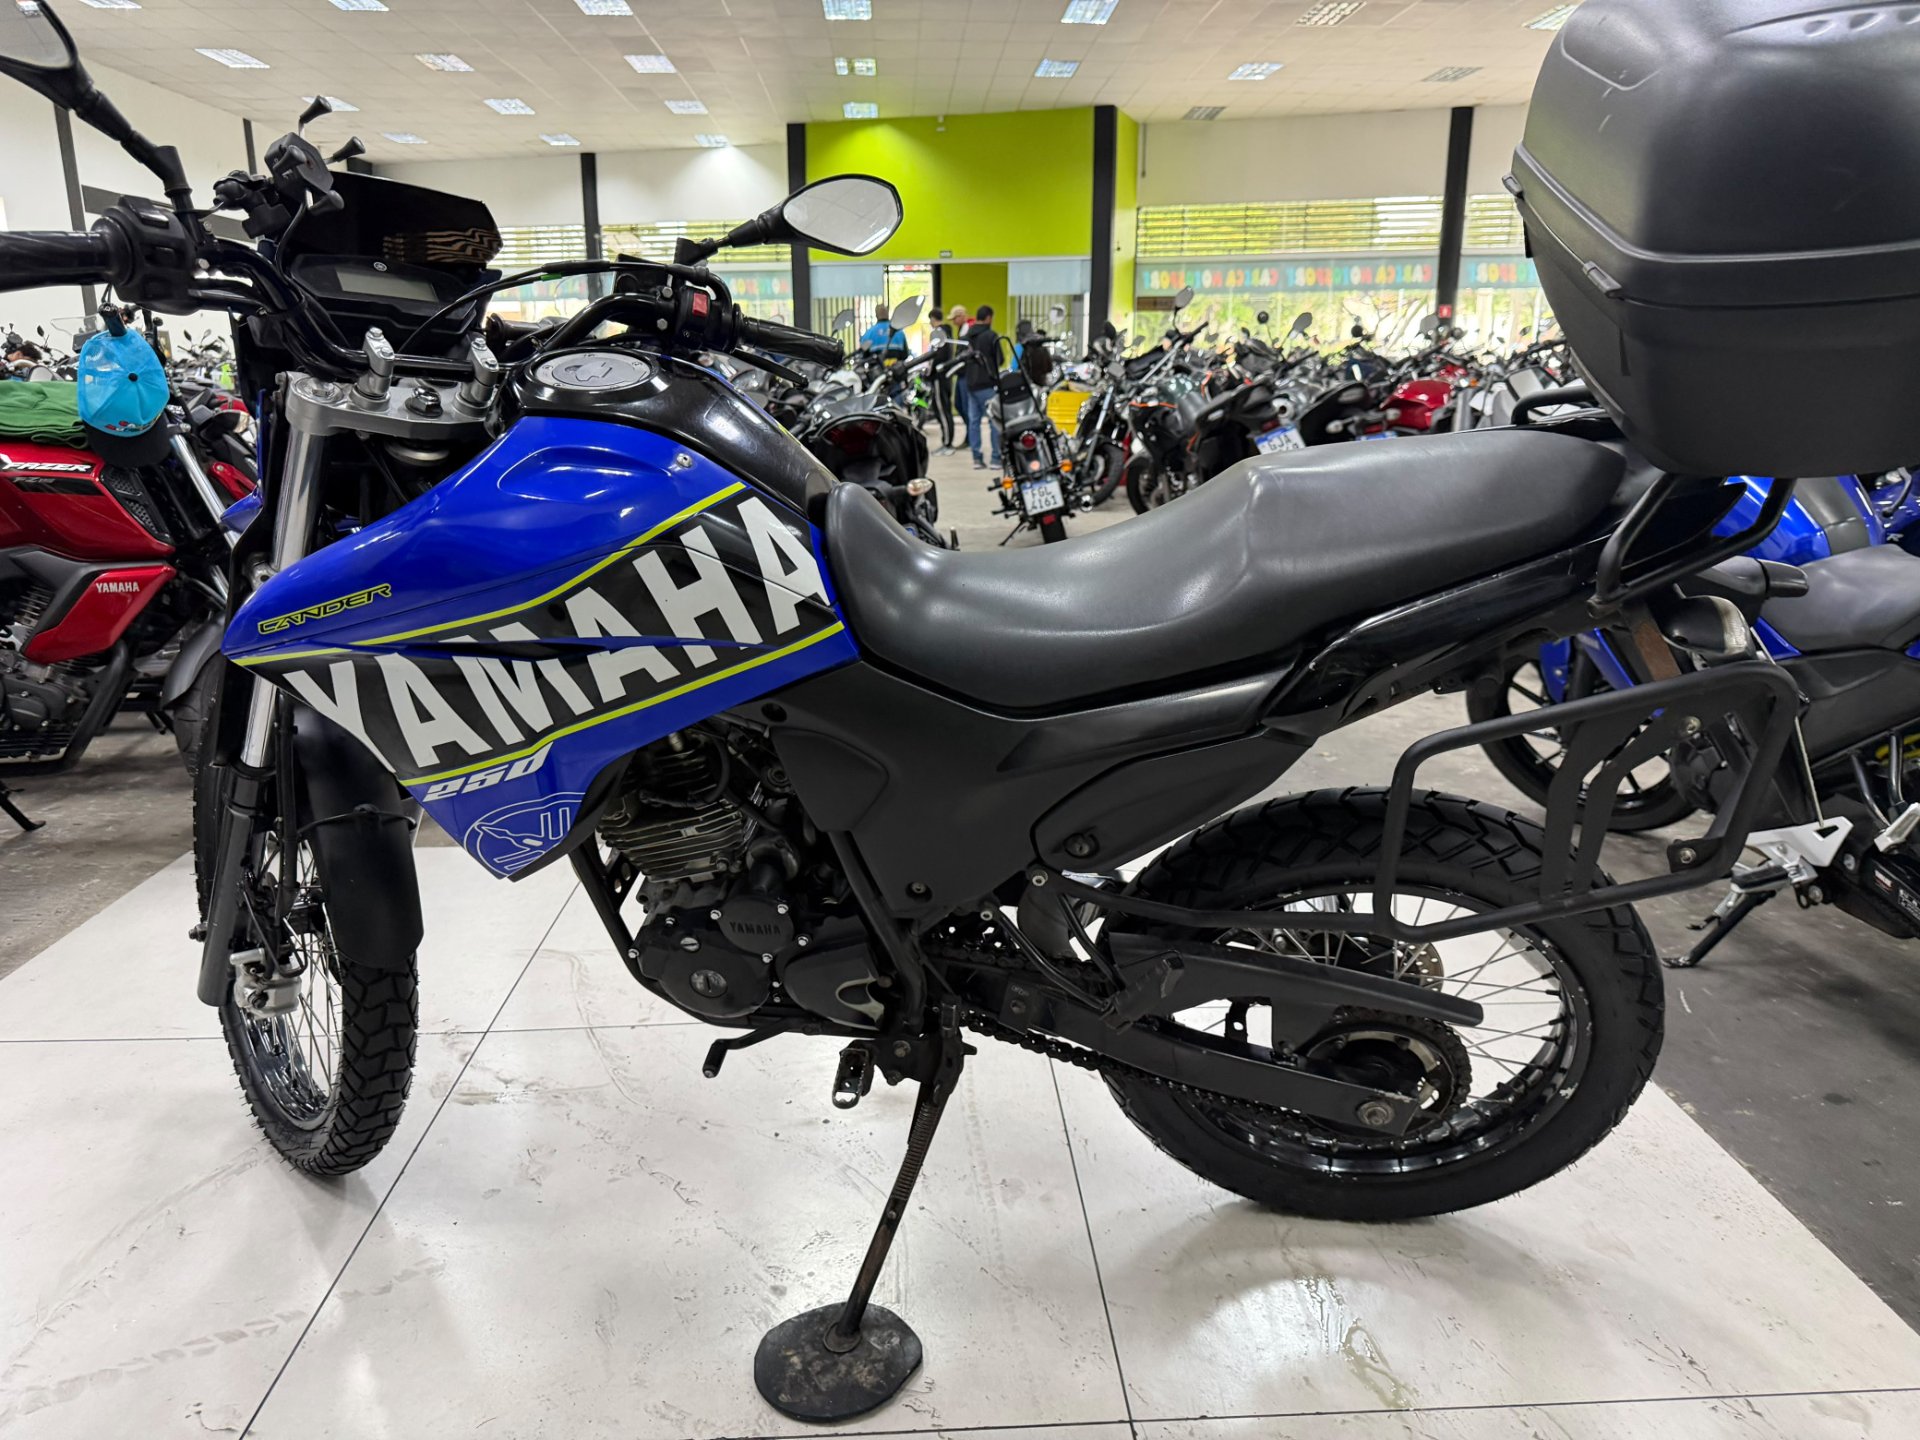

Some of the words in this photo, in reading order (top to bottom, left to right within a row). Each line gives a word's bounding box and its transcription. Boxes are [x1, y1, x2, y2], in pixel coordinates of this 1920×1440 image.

[0, 460, 92, 472] FAZER
[95, 580, 140, 594] YAMAHA
[283, 496, 832, 773] YAMAHA
[423, 741, 554, 803] 250
[729, 921, 782, 936] YAMAHA
